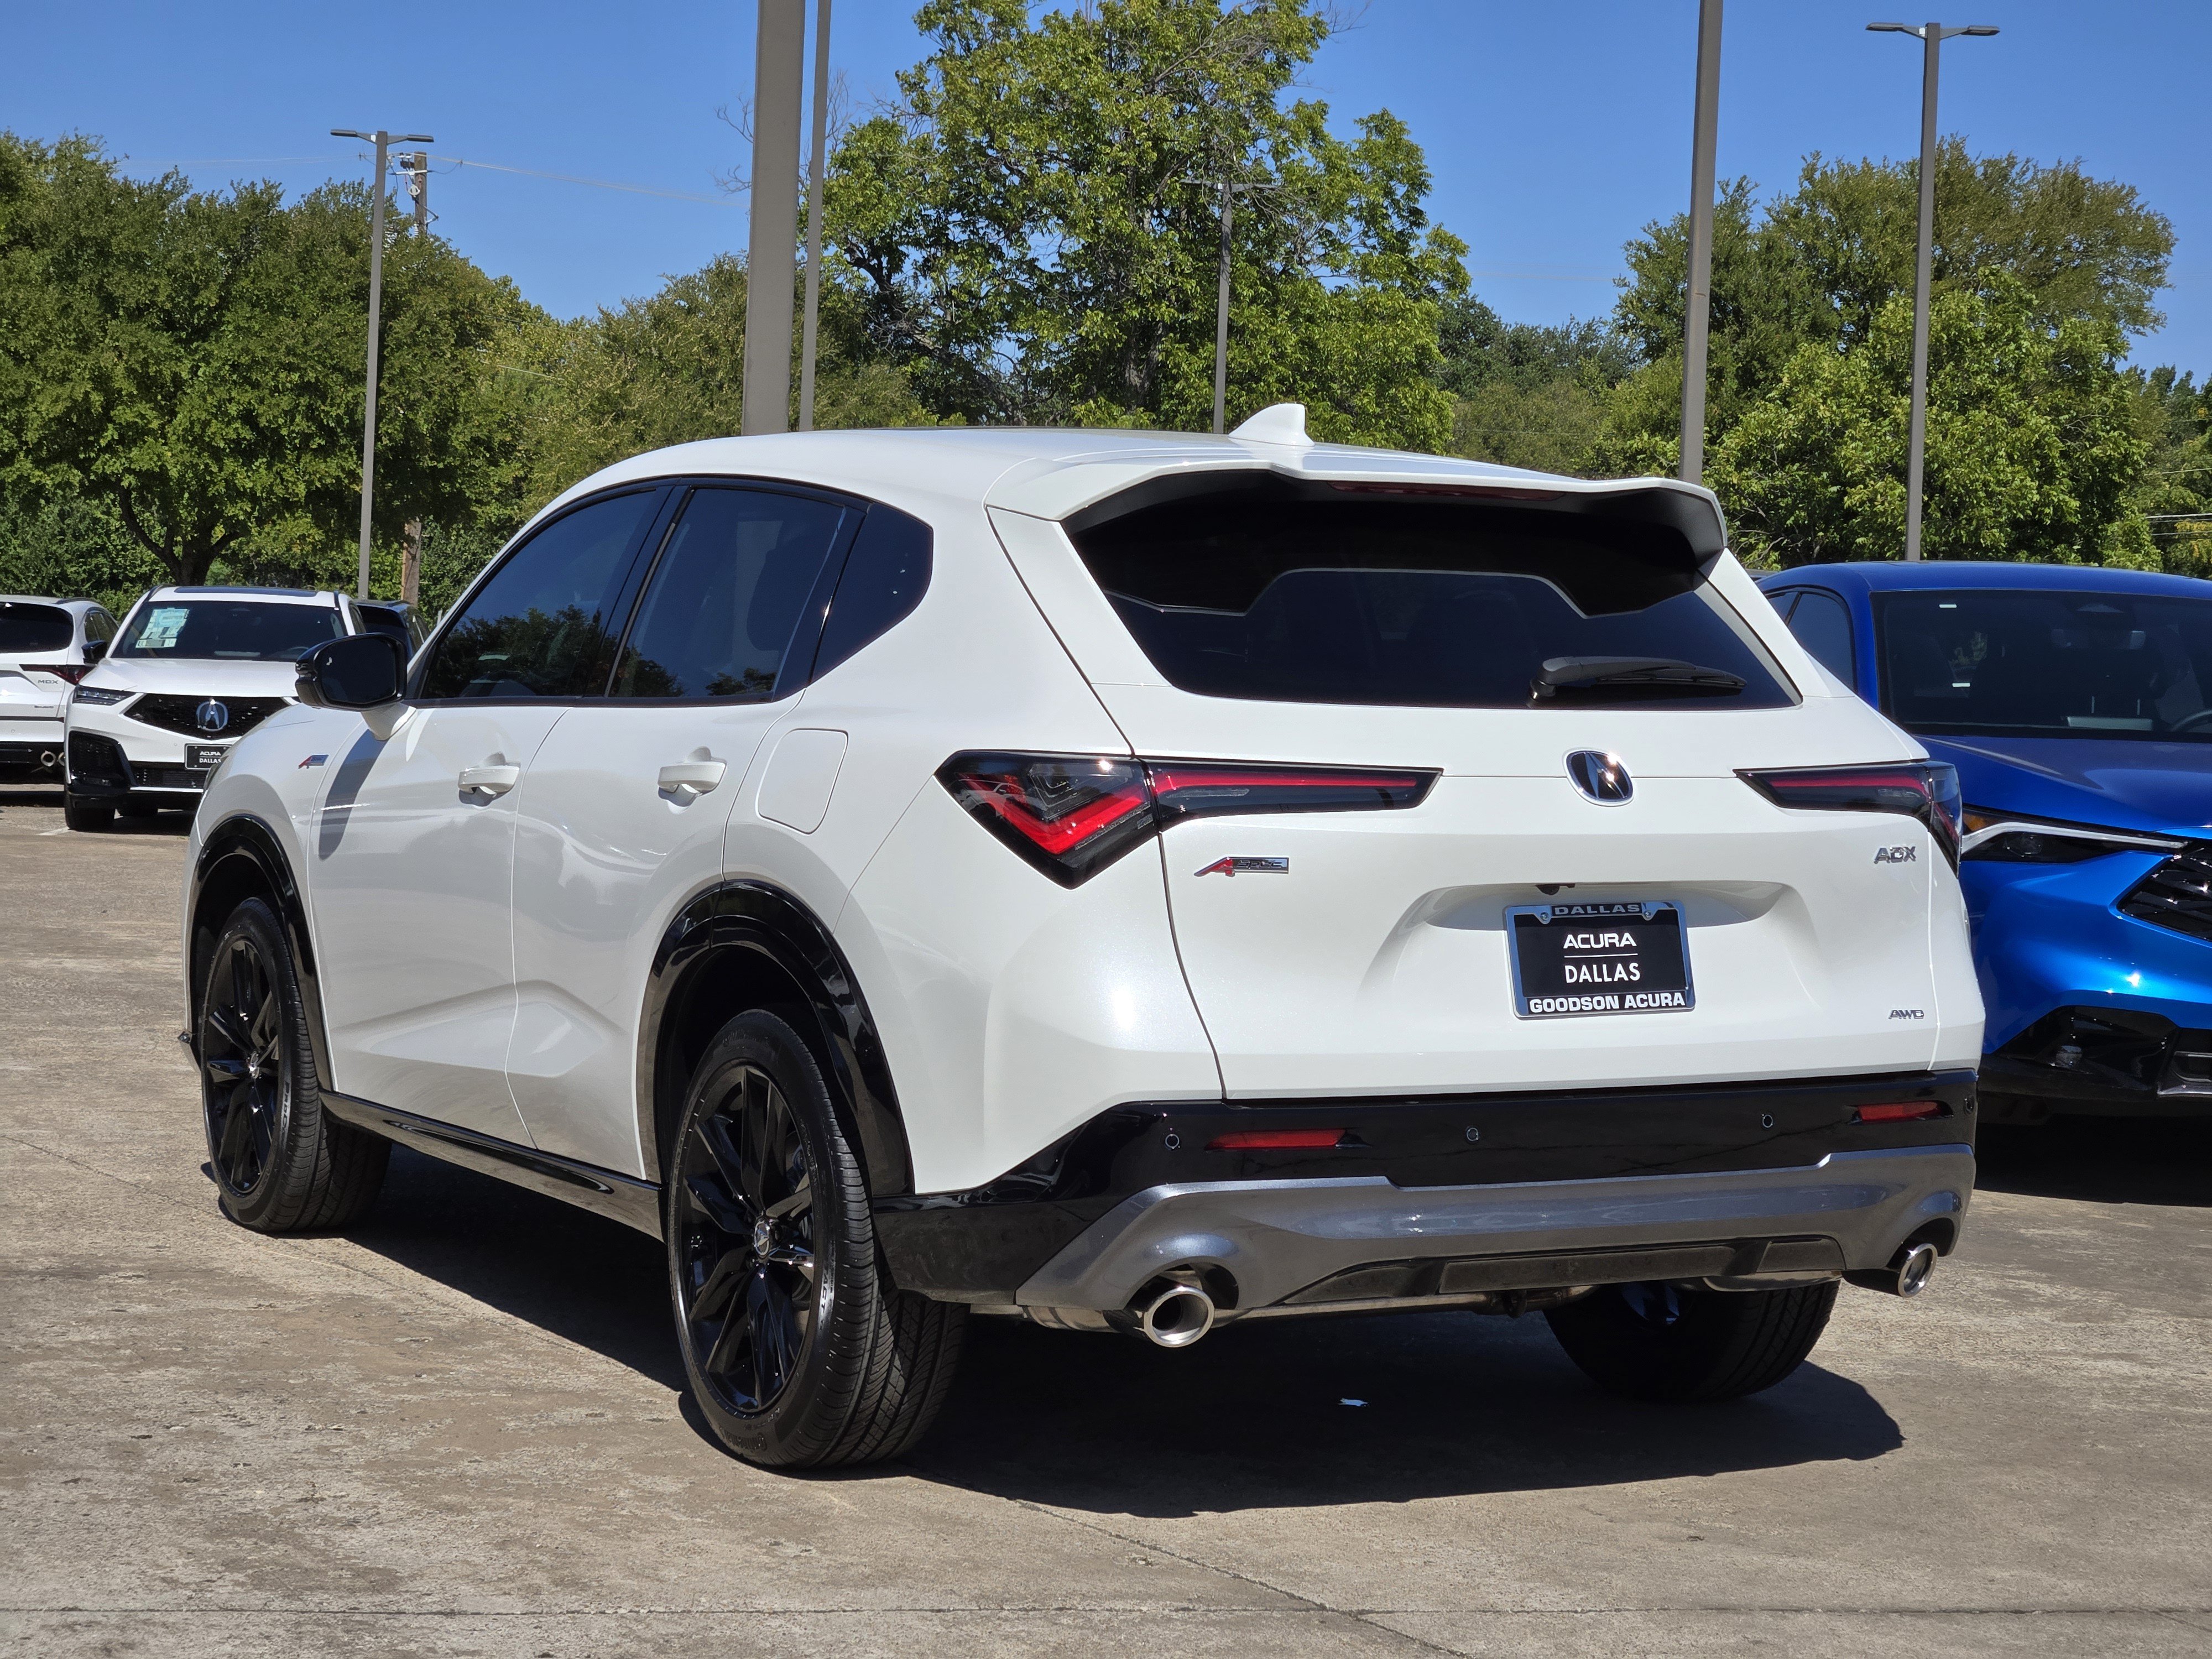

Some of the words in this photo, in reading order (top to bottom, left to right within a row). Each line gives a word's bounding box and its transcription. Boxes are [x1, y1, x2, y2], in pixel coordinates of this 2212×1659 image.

[1874, 846, 1917, 864] ADX
[1554, 904, 1640, 915] DALLAS
[1563, 933, 1637, 949] ACURA
[1564, 963, 1640, 983] DALLAS
[1529, 995, 1620, 1013] GOODSON
[1624, 992, 1686, 1009] ACURA
[1888, 1010, 1924, 1019] AWD
